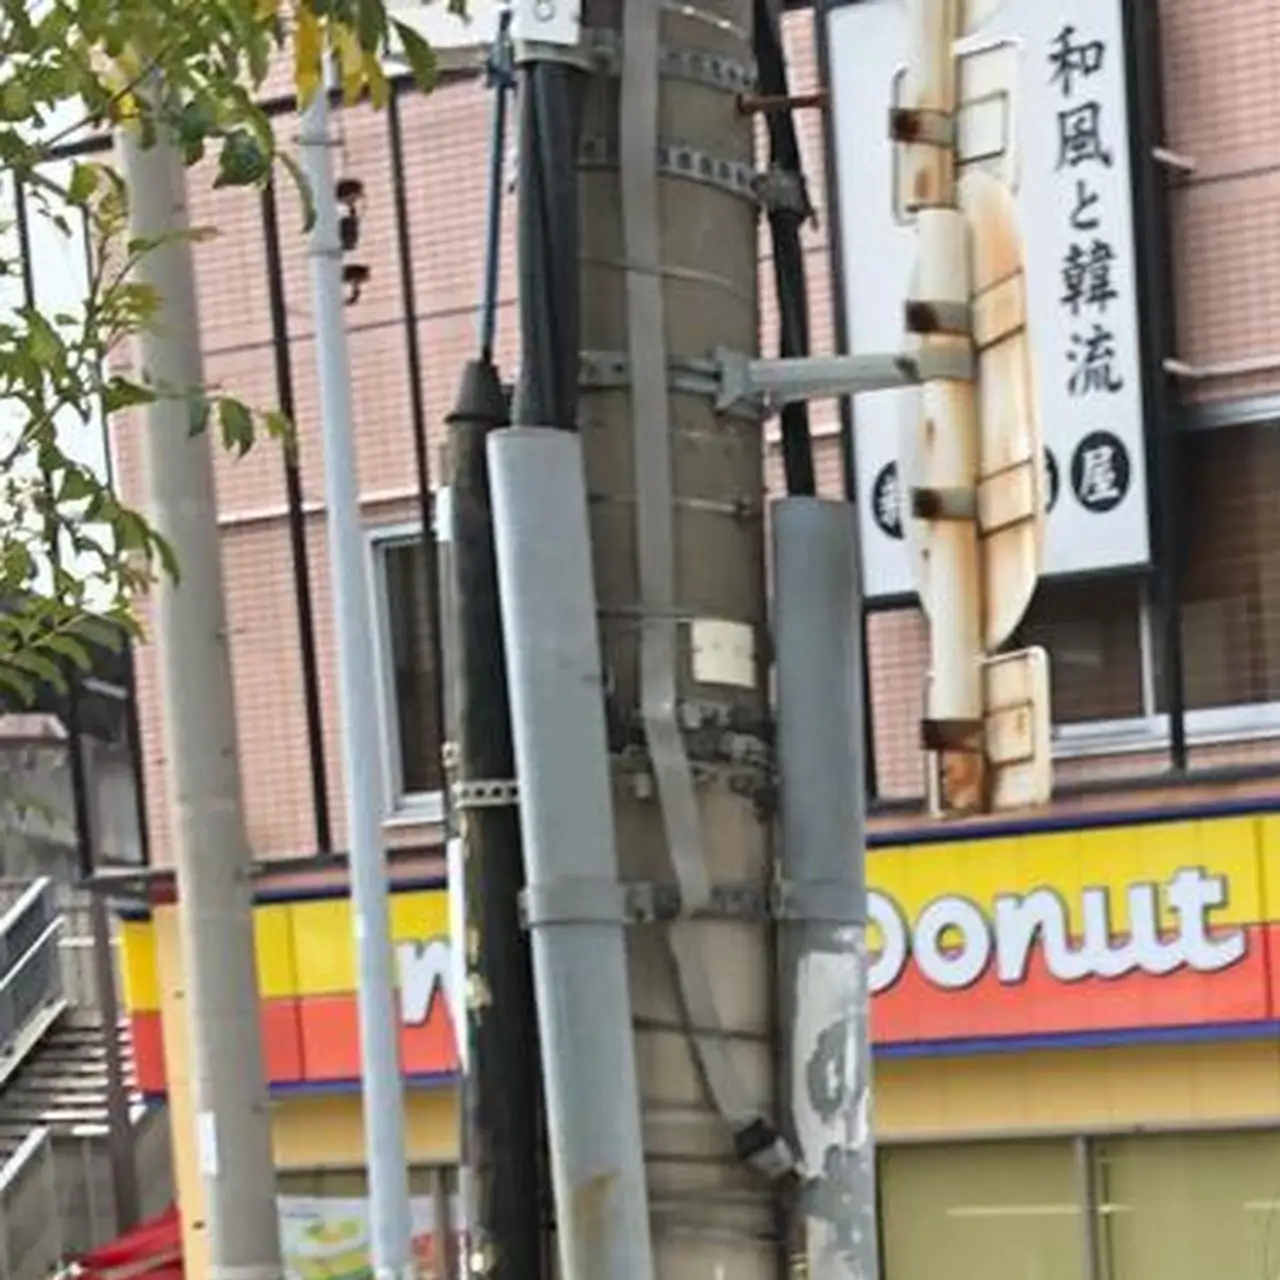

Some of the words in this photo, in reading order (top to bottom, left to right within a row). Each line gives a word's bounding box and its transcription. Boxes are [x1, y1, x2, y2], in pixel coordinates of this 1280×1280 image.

[1048, 26, 1124, 397] 和風と韓流
